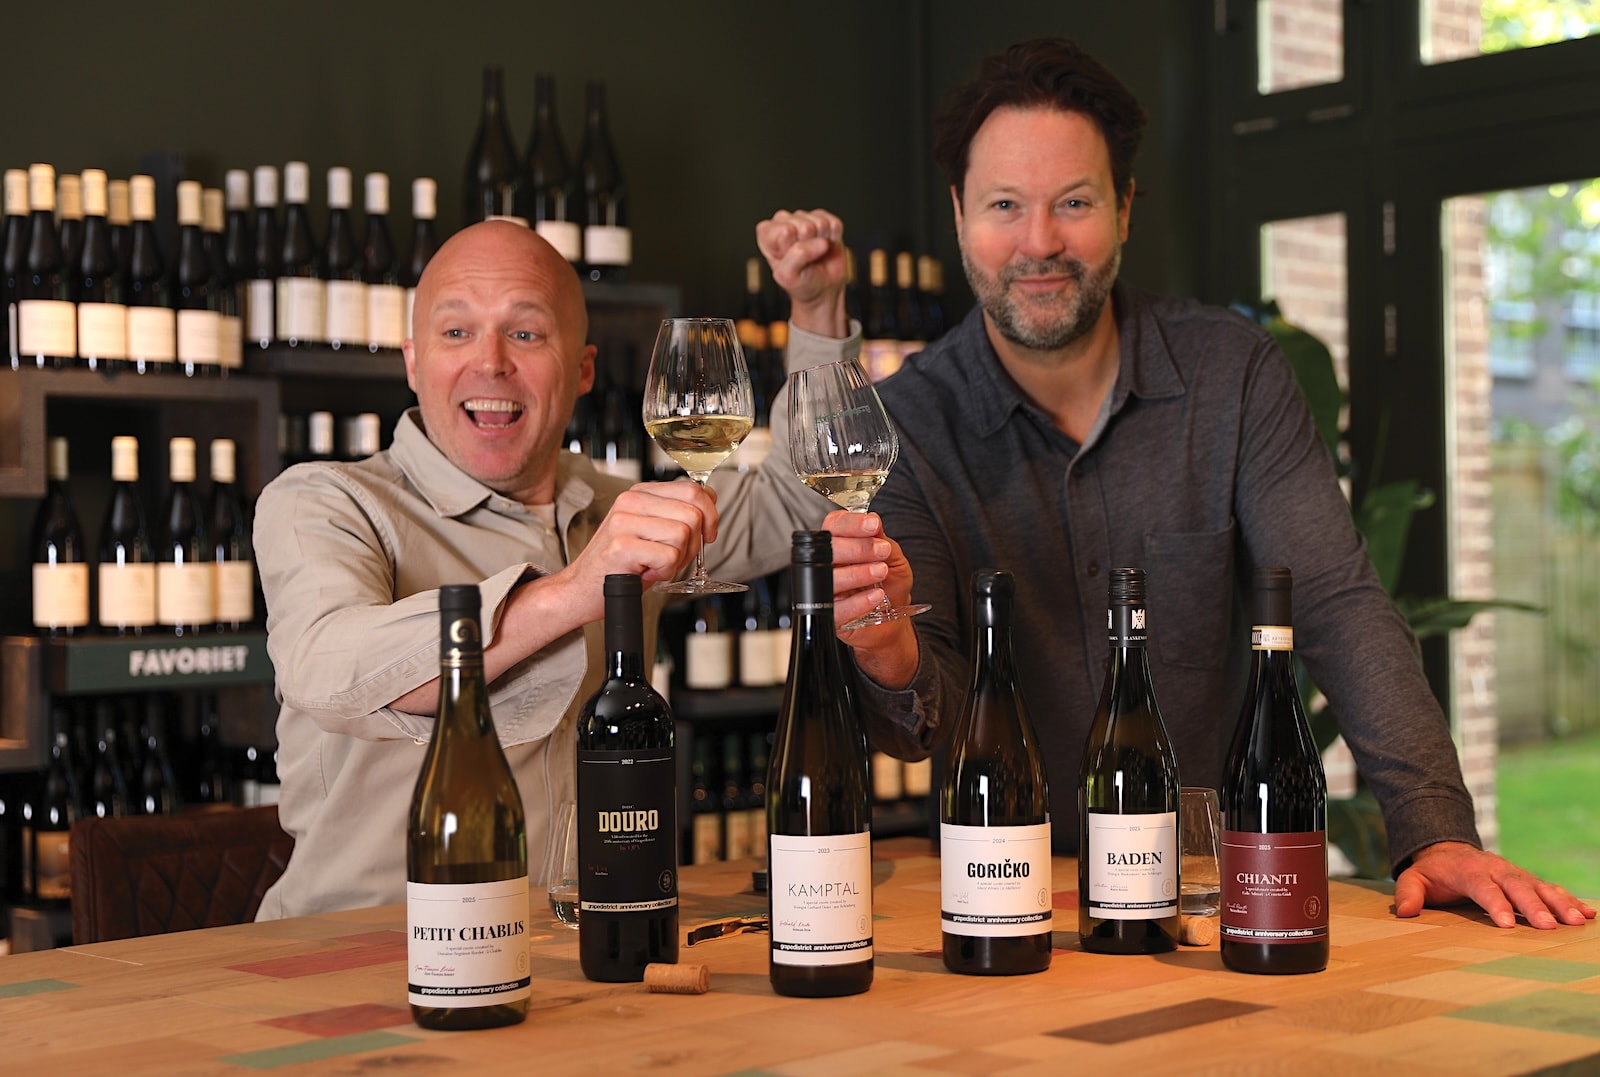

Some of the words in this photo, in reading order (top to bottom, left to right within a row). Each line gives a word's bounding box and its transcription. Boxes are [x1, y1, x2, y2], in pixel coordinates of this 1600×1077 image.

[130, 646, 247, 676] FAVORIET
[598, 809, 659, 832] DOURO
[1107, 851, 1162, 865] BADEN
[967, 858, 1030, 878] GORIČKO
[1236, 872, 1298, 885] CHIANTI
[788, 881, 860, 897] KAMPTAL
[952, 915, 985, 923] grapedistrict
[986, 916, 1021, 924] anniversary
[1021, 914, 1043, 922] collection
[414, 926, 455, 941] PETIT
[459, 920, 524, 941] CHABLIS
[1226, 928, 1253, 936] grapedistrict
[1254, 930, 1288, 938] anniversary
[813, 943, 847, 951] anniversary
[847, 940, 868, 948] collection
[421, 987, 456, 995] grapedistrict
[457, 986, 495, 995] anniversary
[495, 982, 519, 991] collection
